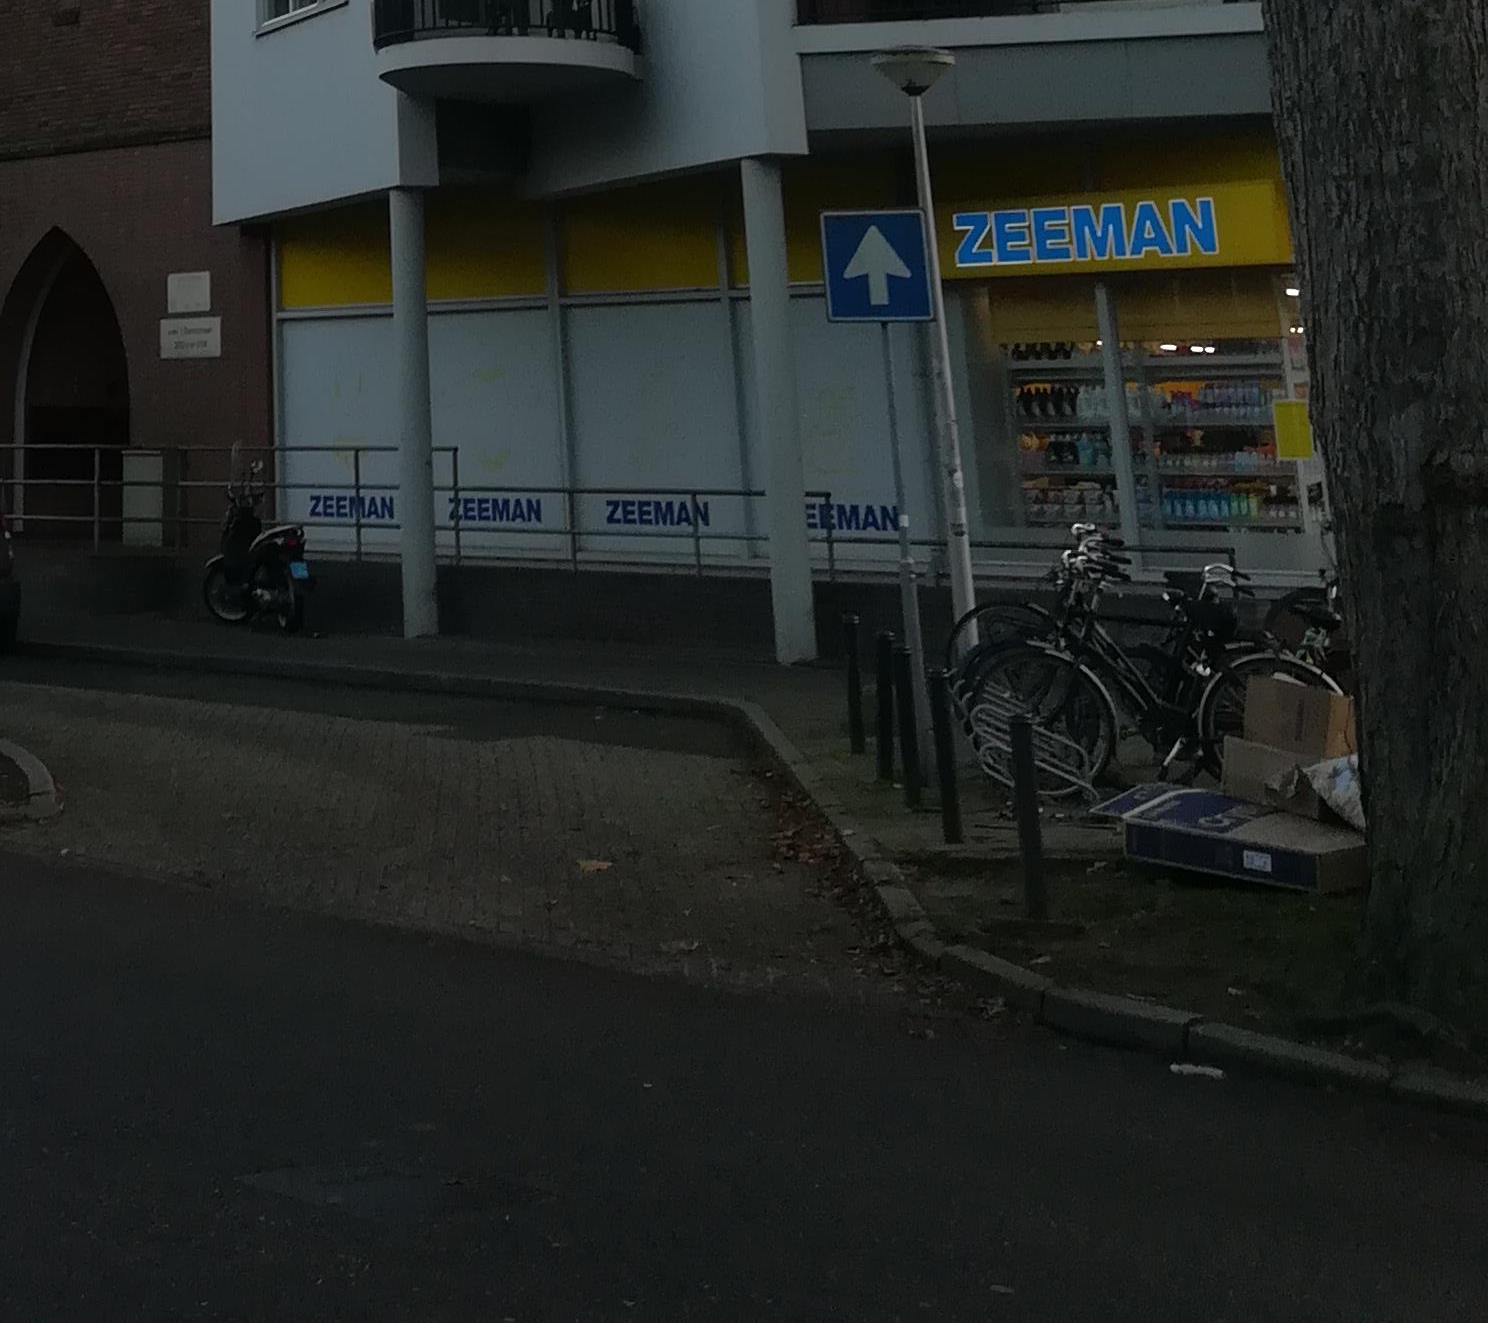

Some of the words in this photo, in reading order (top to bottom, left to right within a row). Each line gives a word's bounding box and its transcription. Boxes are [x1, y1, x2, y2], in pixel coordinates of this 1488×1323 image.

[952, 197, 1219, 267] ZEEMAN
[309, 495, 395, 520] ZEEMAN
[448, 497, 541, 522] ZEEMAN
[606, 499, 710, 526] ZEEMAN
[806, 503, 899, 532] EEMAN
